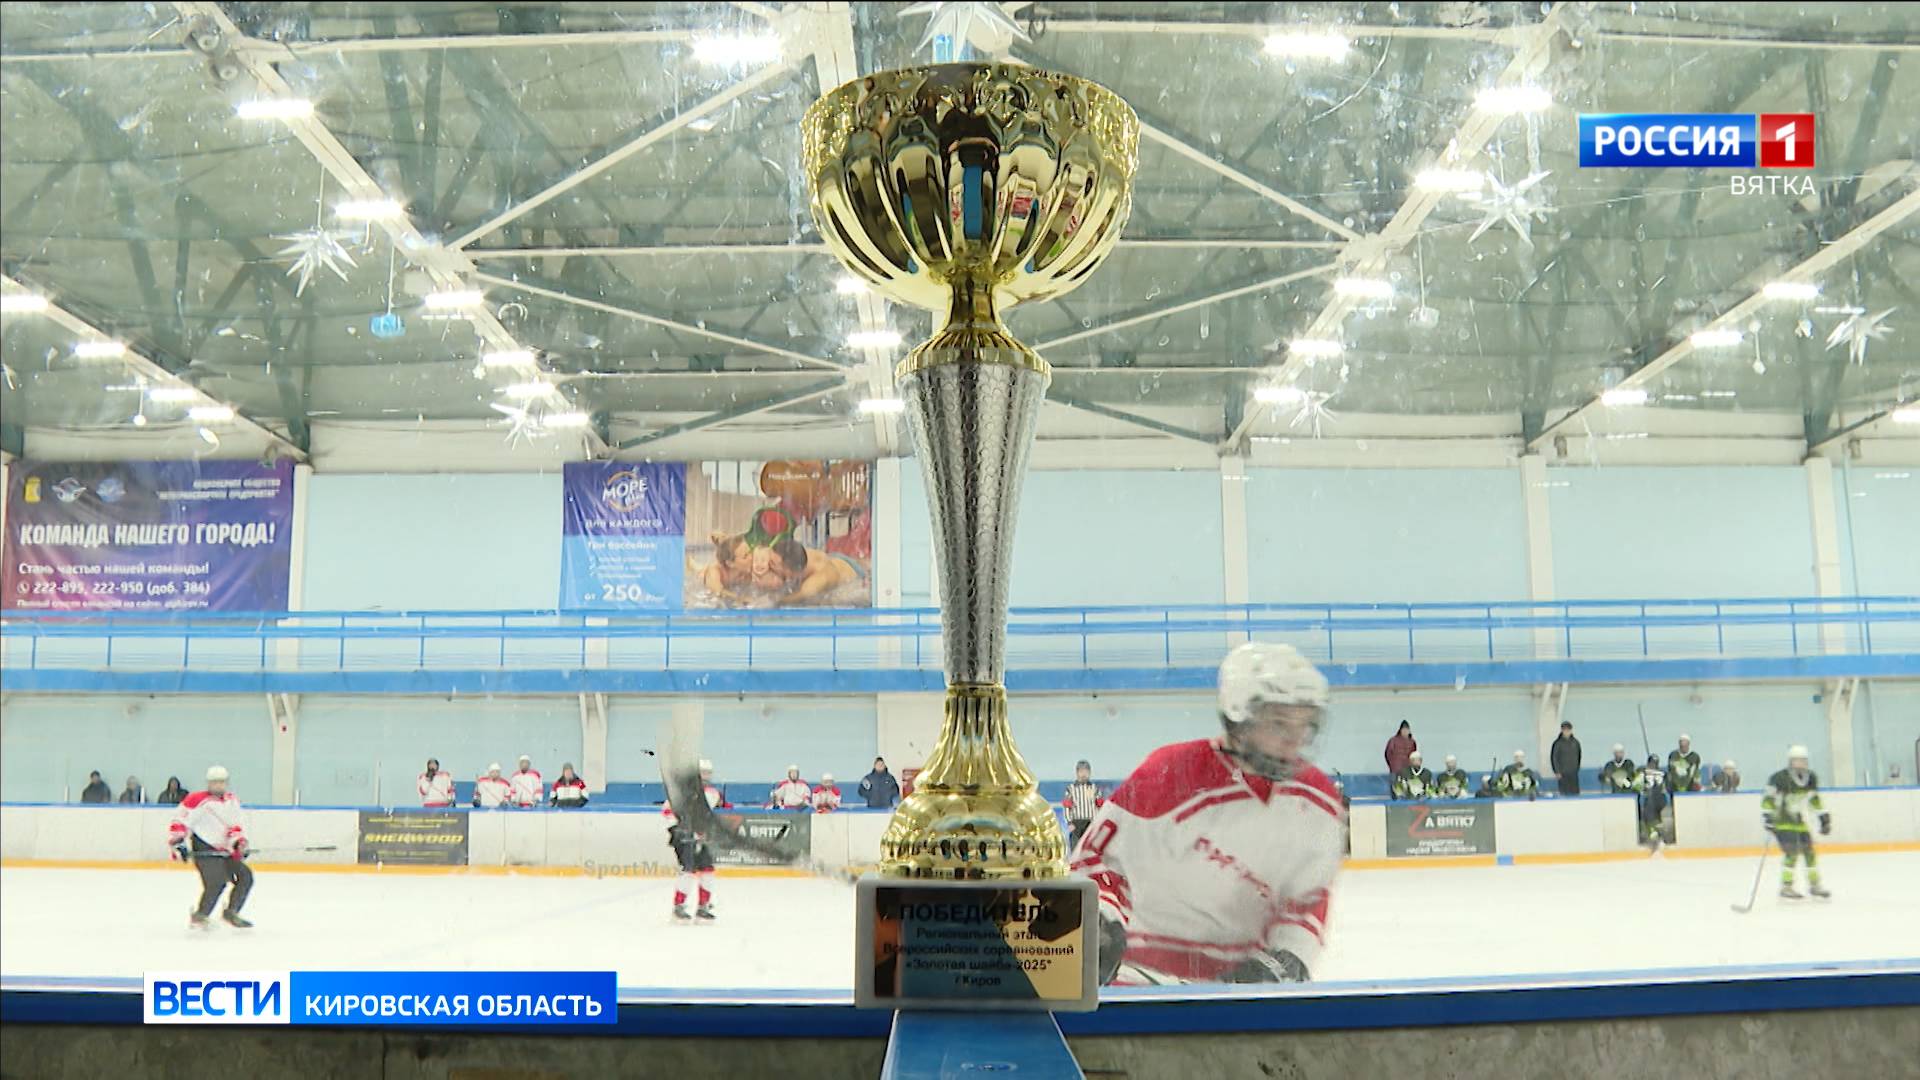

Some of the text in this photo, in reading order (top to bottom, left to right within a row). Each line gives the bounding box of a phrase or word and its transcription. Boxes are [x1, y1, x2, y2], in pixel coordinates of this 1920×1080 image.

[602, 477, 648, 502] МОРЕ
[20, 522, 276, 548] КОМАНДА НАШЕГО ГОРОДА!
[18, 562, 54, 575] Стань
[103, 561, 145, 574] нашей
[602, 583, 642, 602] 250
[364, 832, 464, 844] SHERWOOD
[900, 903, 1059, 924] ПОБЕДИТЕЛЬ
[1013, 930, 1042, 940] эта
